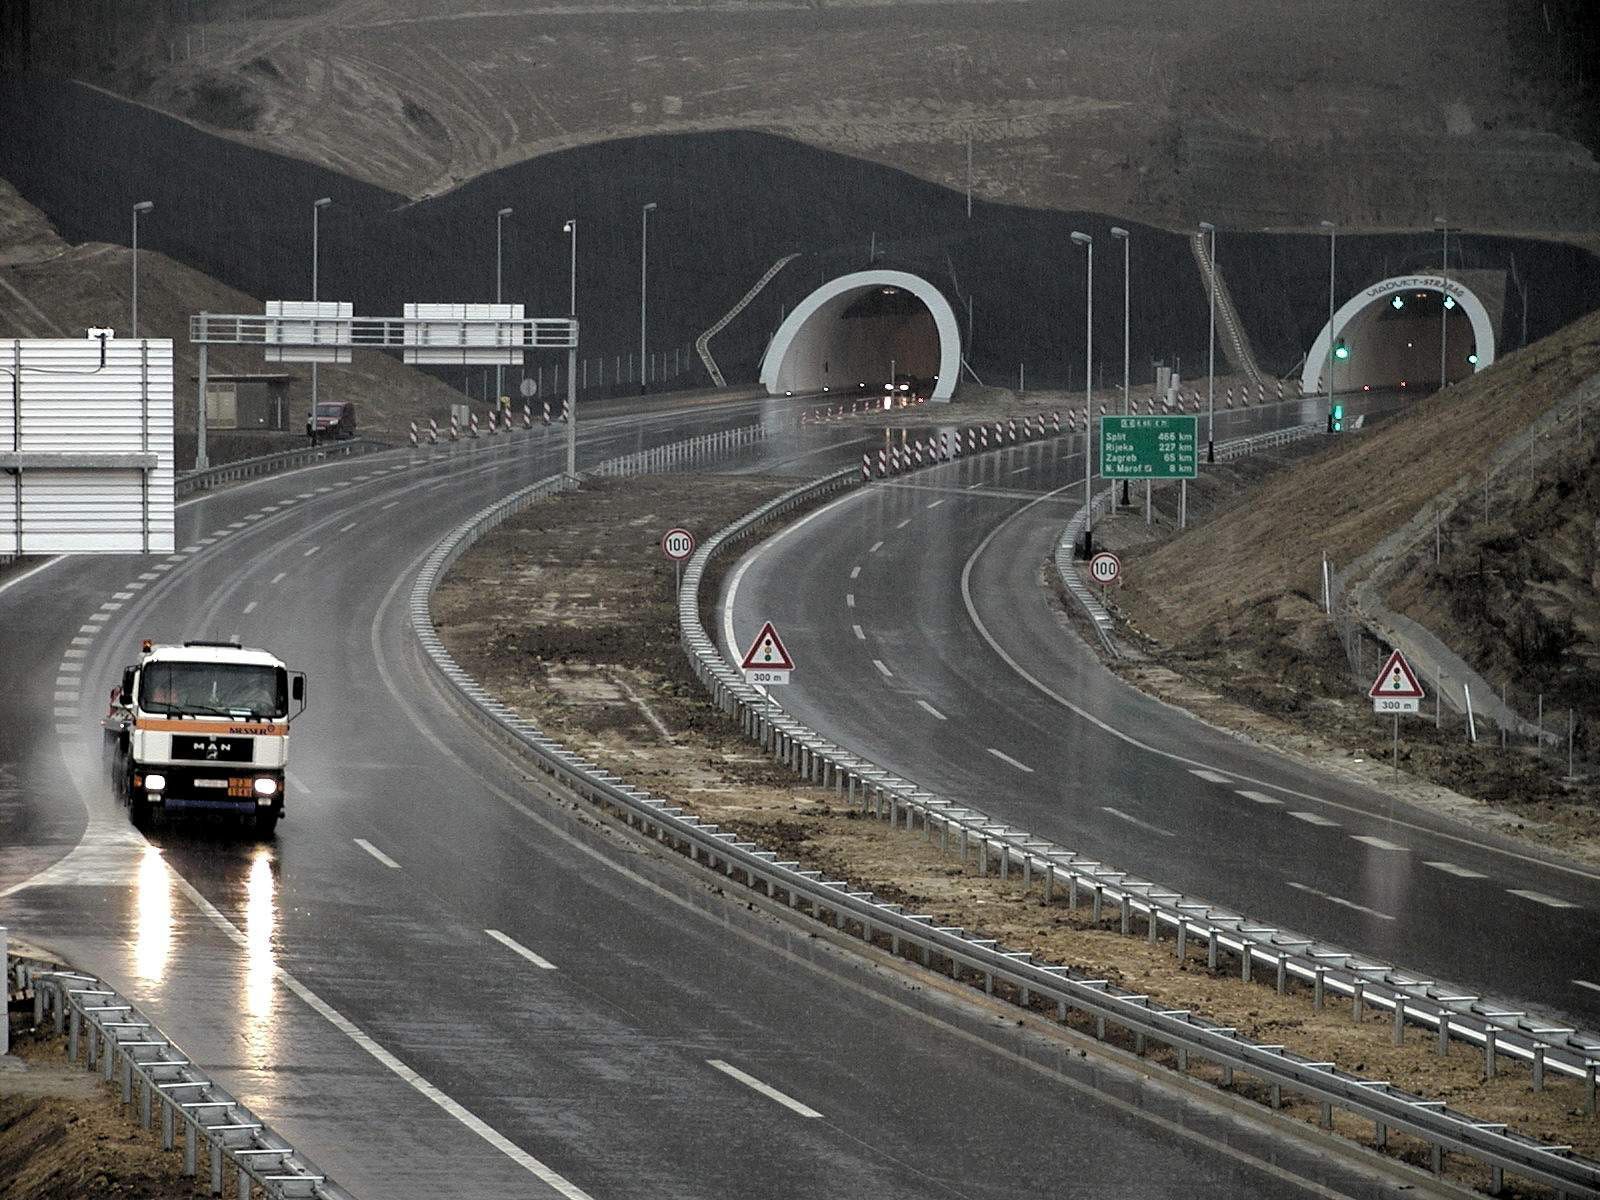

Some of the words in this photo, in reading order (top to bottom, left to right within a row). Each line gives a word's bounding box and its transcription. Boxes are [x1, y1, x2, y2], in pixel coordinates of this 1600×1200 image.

[1105, 432, 1127, 442] Split
[1179, 432, 1193, 441] km
[1105, 443, 1134, 453] Rijeka
[1159, 443, 1176, 451] 227
[1179, 443, 1193, 451] km
[1105, 453, 1137, 463] Zagreb
[1163, 453, 1176, 462] 65
[1179, 453, 1193, 462] km
[1117, 464, 1142, 472] Marof
[1169, 464, 1176, 472] 8
[1178, 464, 1193, 472] km
[669, 538, 689, 551] 100
[1096, 562, 1116, 575] 100
[753, 673, 771, 681] 300
[1382, 701, 1400, 709] 300
[193, 742, 231, 751] MAN
